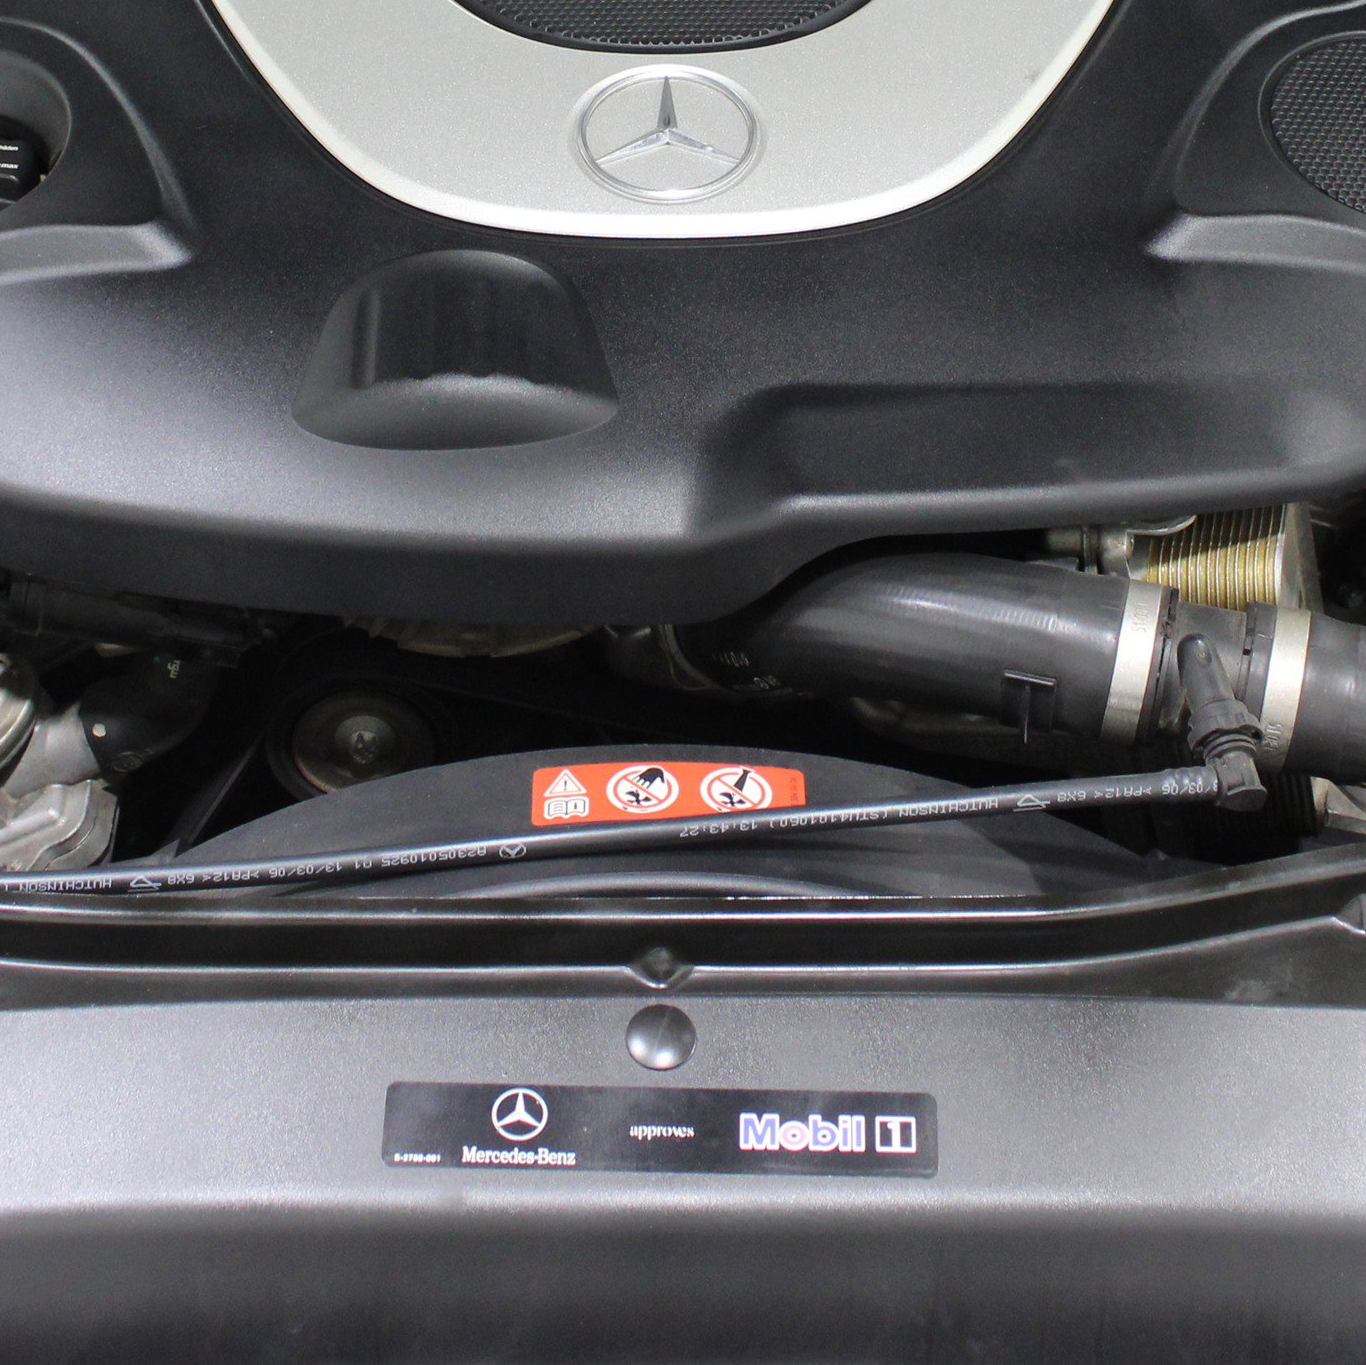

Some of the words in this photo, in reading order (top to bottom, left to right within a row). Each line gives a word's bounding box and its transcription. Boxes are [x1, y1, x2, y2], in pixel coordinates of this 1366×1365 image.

[898, 800, 999, 818] HUTCHINSON
[381, 846, 487, 868] A2305010925
[167, 874, 195, 885] 6X8
[629, 1125, 695, 1140] approves
[739, 1113, 865, 1152] Mobil
[462, 1145, 577, 1166] Mercedes-Benz
